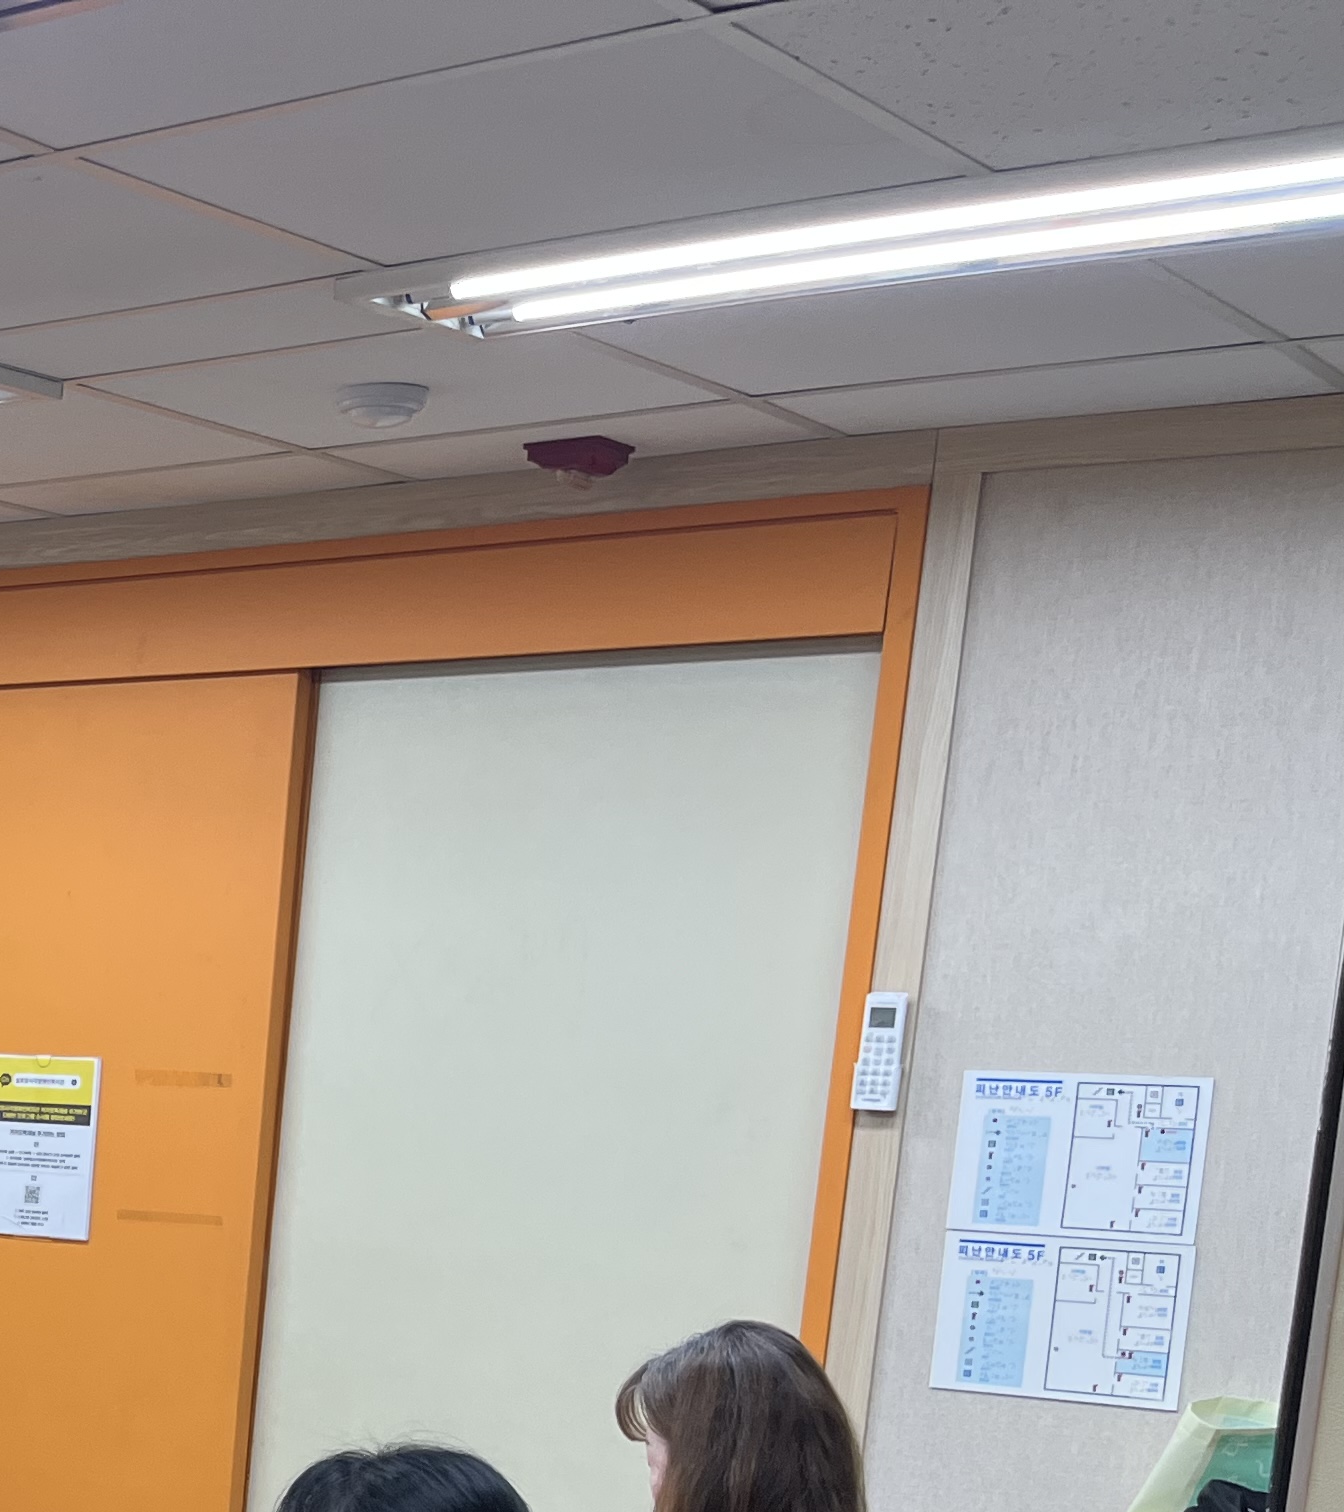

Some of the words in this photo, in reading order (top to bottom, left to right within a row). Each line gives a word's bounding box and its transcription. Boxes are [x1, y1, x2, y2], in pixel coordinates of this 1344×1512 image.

[975, 1083, 1040, 1097] 피난안내도
[1045, 1085, 1063, 1098] 5F
[958, 1244, 1022, 1260] 피난안내도
[1027, 1249, 1045, 1262] 5F
